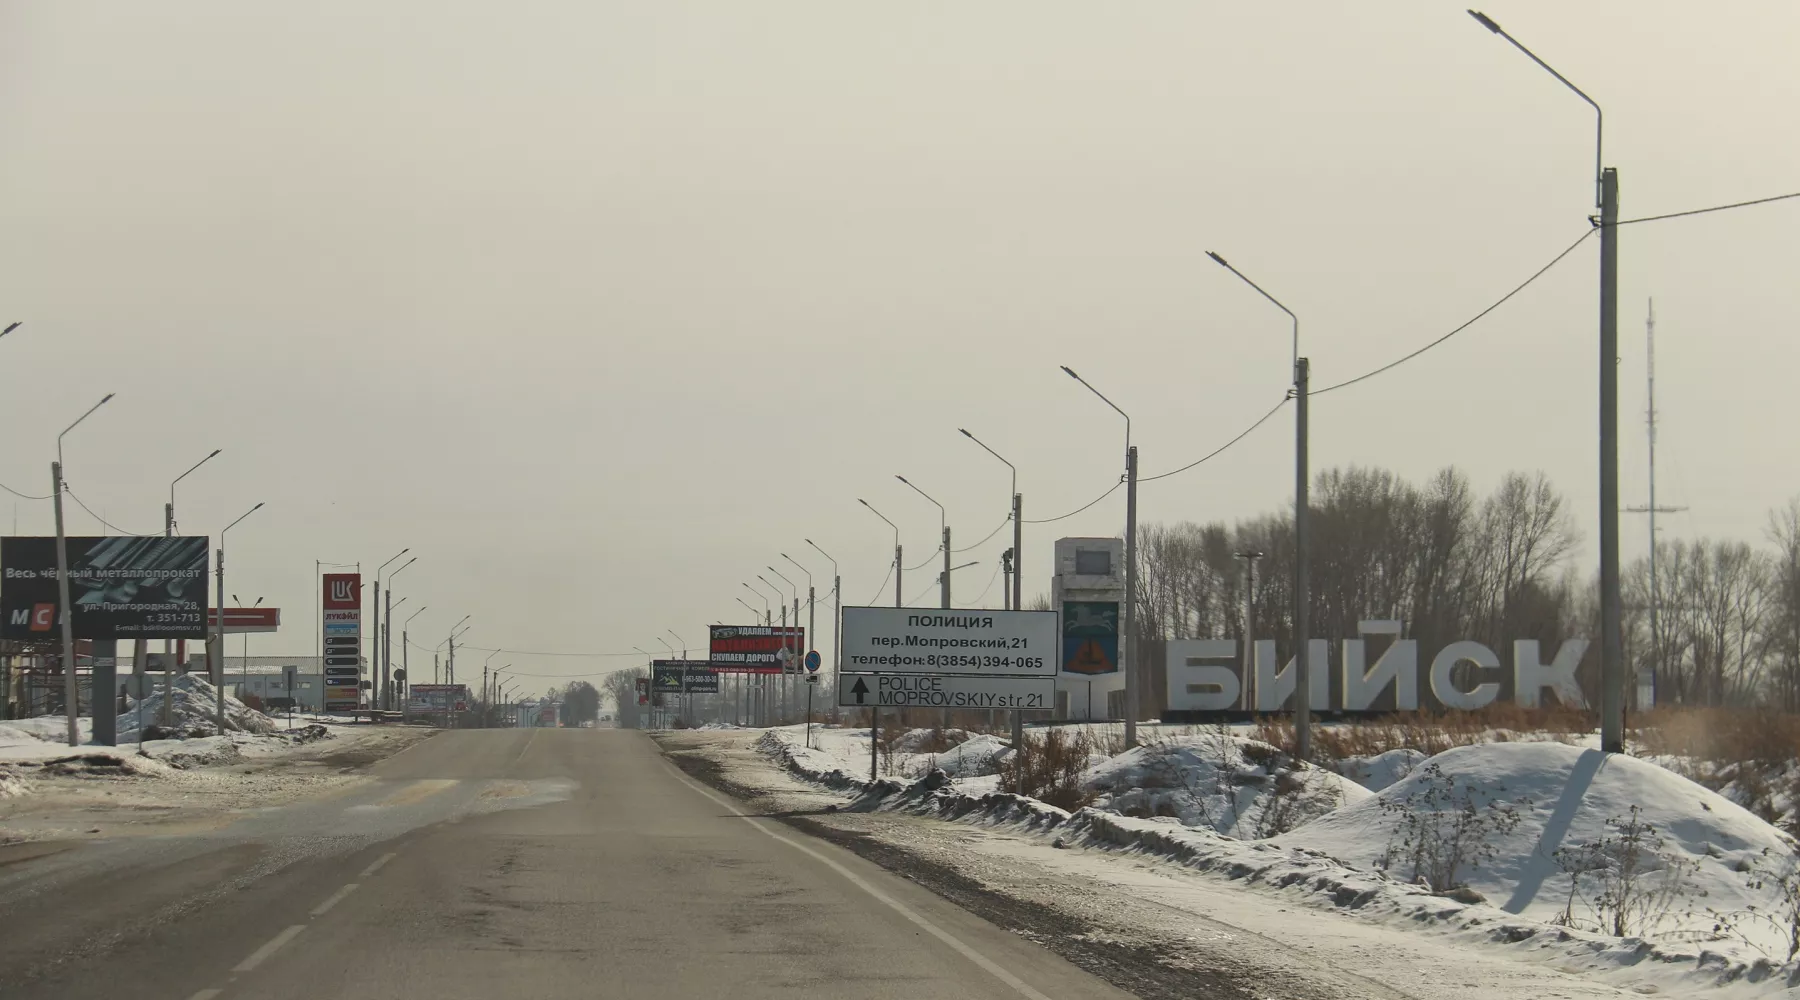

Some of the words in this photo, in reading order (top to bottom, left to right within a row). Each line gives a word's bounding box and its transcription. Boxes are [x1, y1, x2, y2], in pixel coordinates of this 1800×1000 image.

[6, 567, 37, 578] Весь
[96, 568, 201, 580] металлопрокат
[83, 602, 100, 612] ул.
[103, 601, 181, 612] Пригородная,
[184, 601, 200, 611] 28,
[157, 613, 201, 622] 351-713
[325, 611, 358, 620] ЛУКОЙЛ
[908, 615, 993, 629] ПОЛИЦИЯ
[738, 627, 772, 636] УДАЛЯЕМ
[711, 652, 745, 662] СКУПАЕМ
[745, 653, 775, 663] ДОРОГО
[1166, 620, 1590, 711] БИЙСК
[879, 676, 942, 691] POLICE
